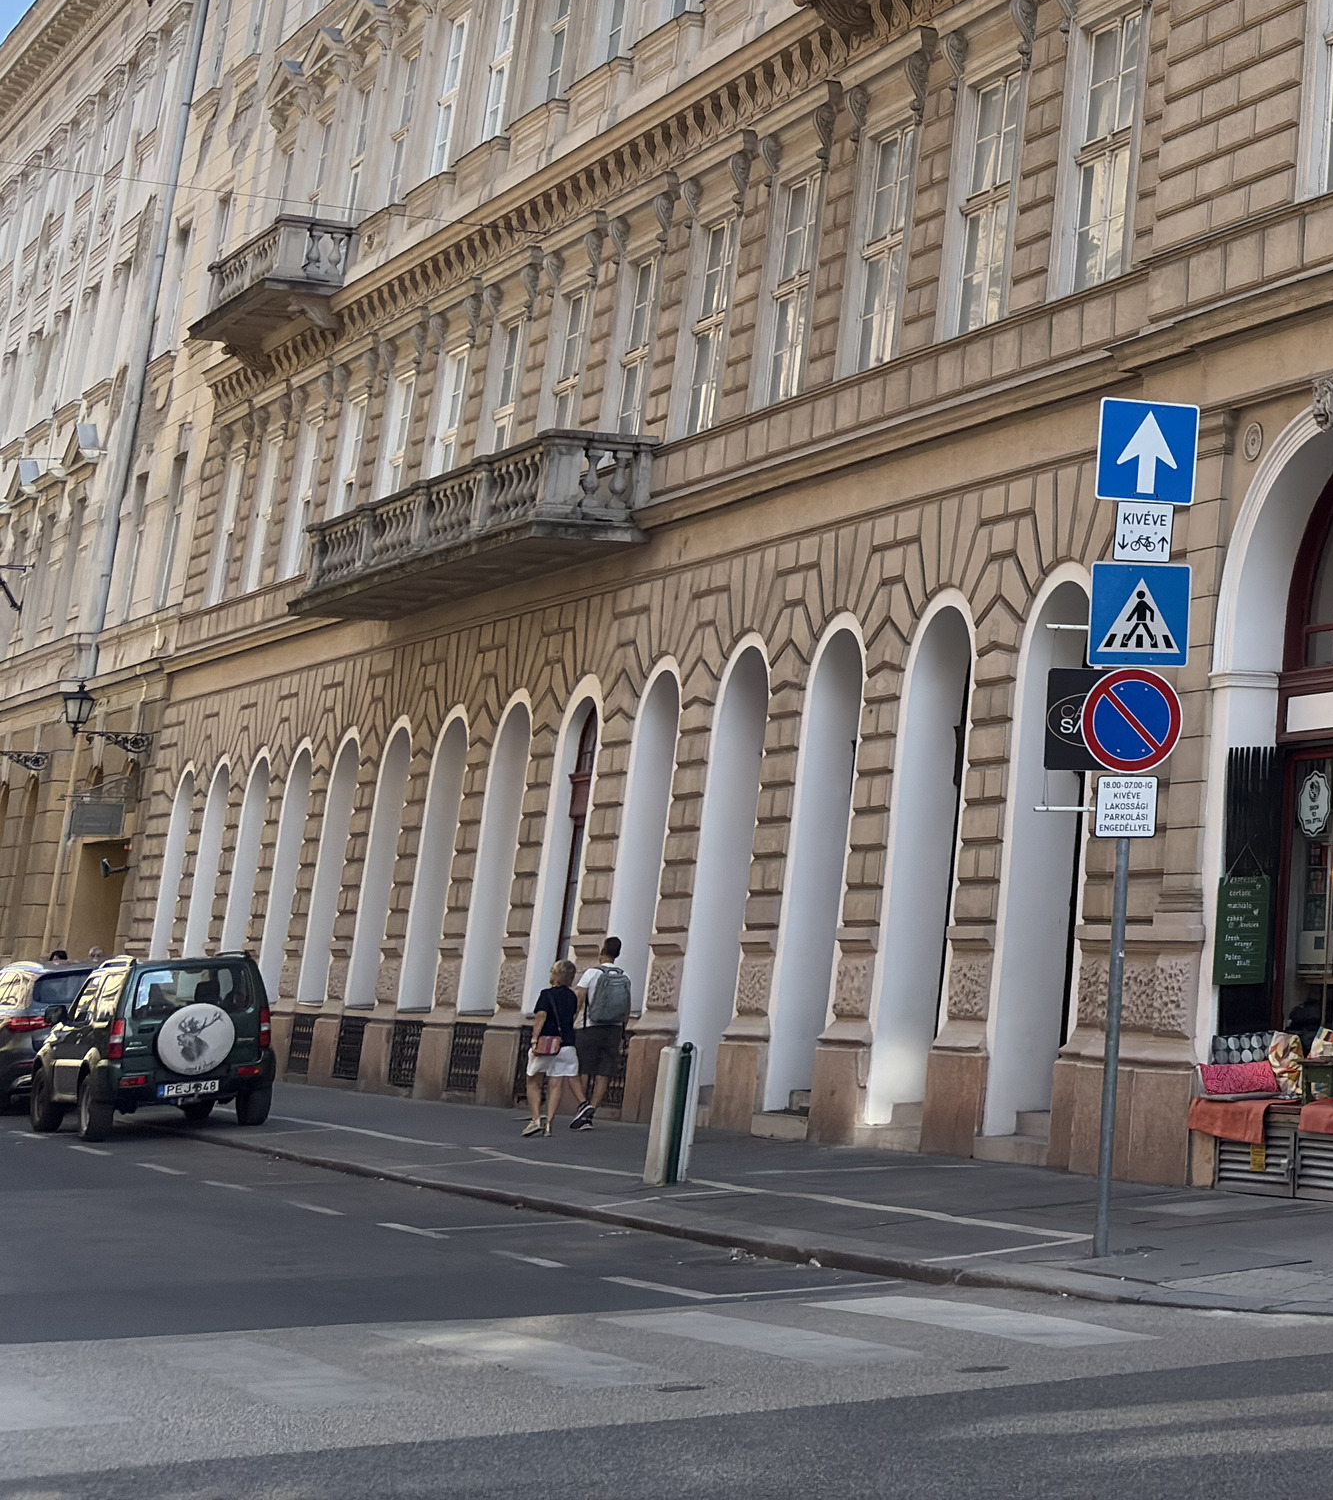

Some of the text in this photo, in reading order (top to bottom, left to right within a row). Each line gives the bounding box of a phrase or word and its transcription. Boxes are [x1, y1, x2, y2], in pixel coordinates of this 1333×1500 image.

[1123, 511, 1167, 526] KIVÉVE
[1113, 791, 1142, 799] KIVÉVE
[1105, 801, 1148, 810] LAKOSSÁGI
[1104, 812, 1148, 820] PARKOLÁSI
[1099, 822, 1151, 831] ENGEDÉLLYEL
